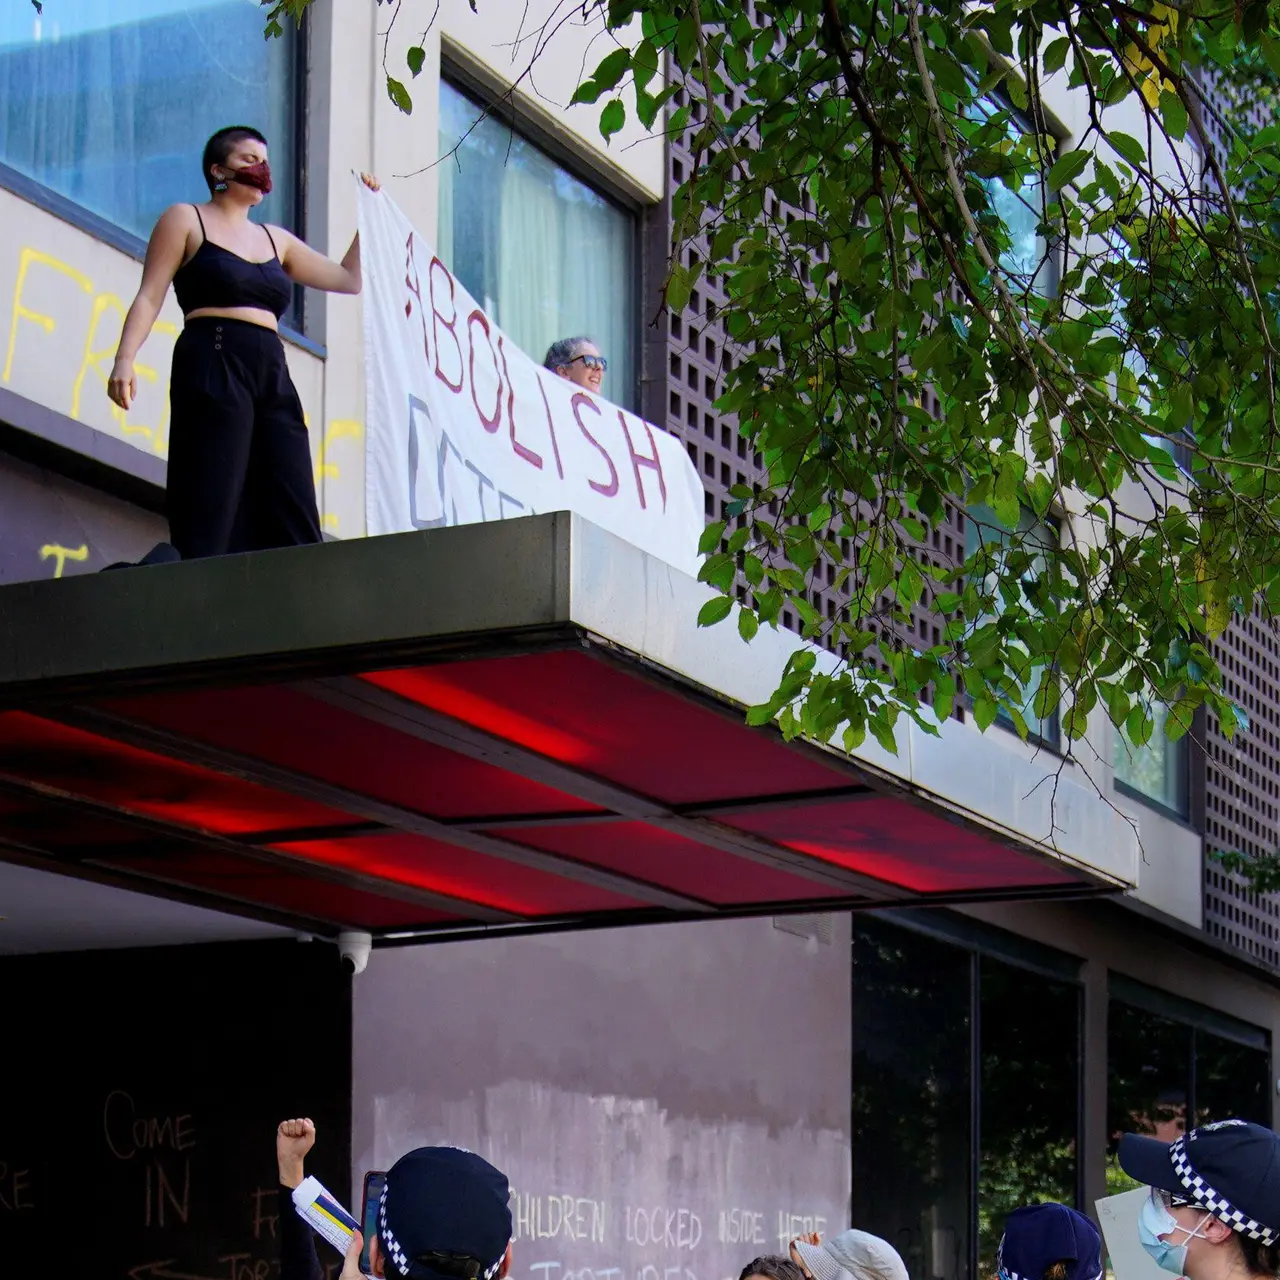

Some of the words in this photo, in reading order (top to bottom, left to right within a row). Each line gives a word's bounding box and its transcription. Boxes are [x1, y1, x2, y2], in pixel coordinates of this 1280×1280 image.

[404, 231, 668, 514] ABOLISH
[103, 1089, 197, 1160] COME
[144, 1160, 192, 1229] IN
[625, 1206, 703, 1250] LOCKED
